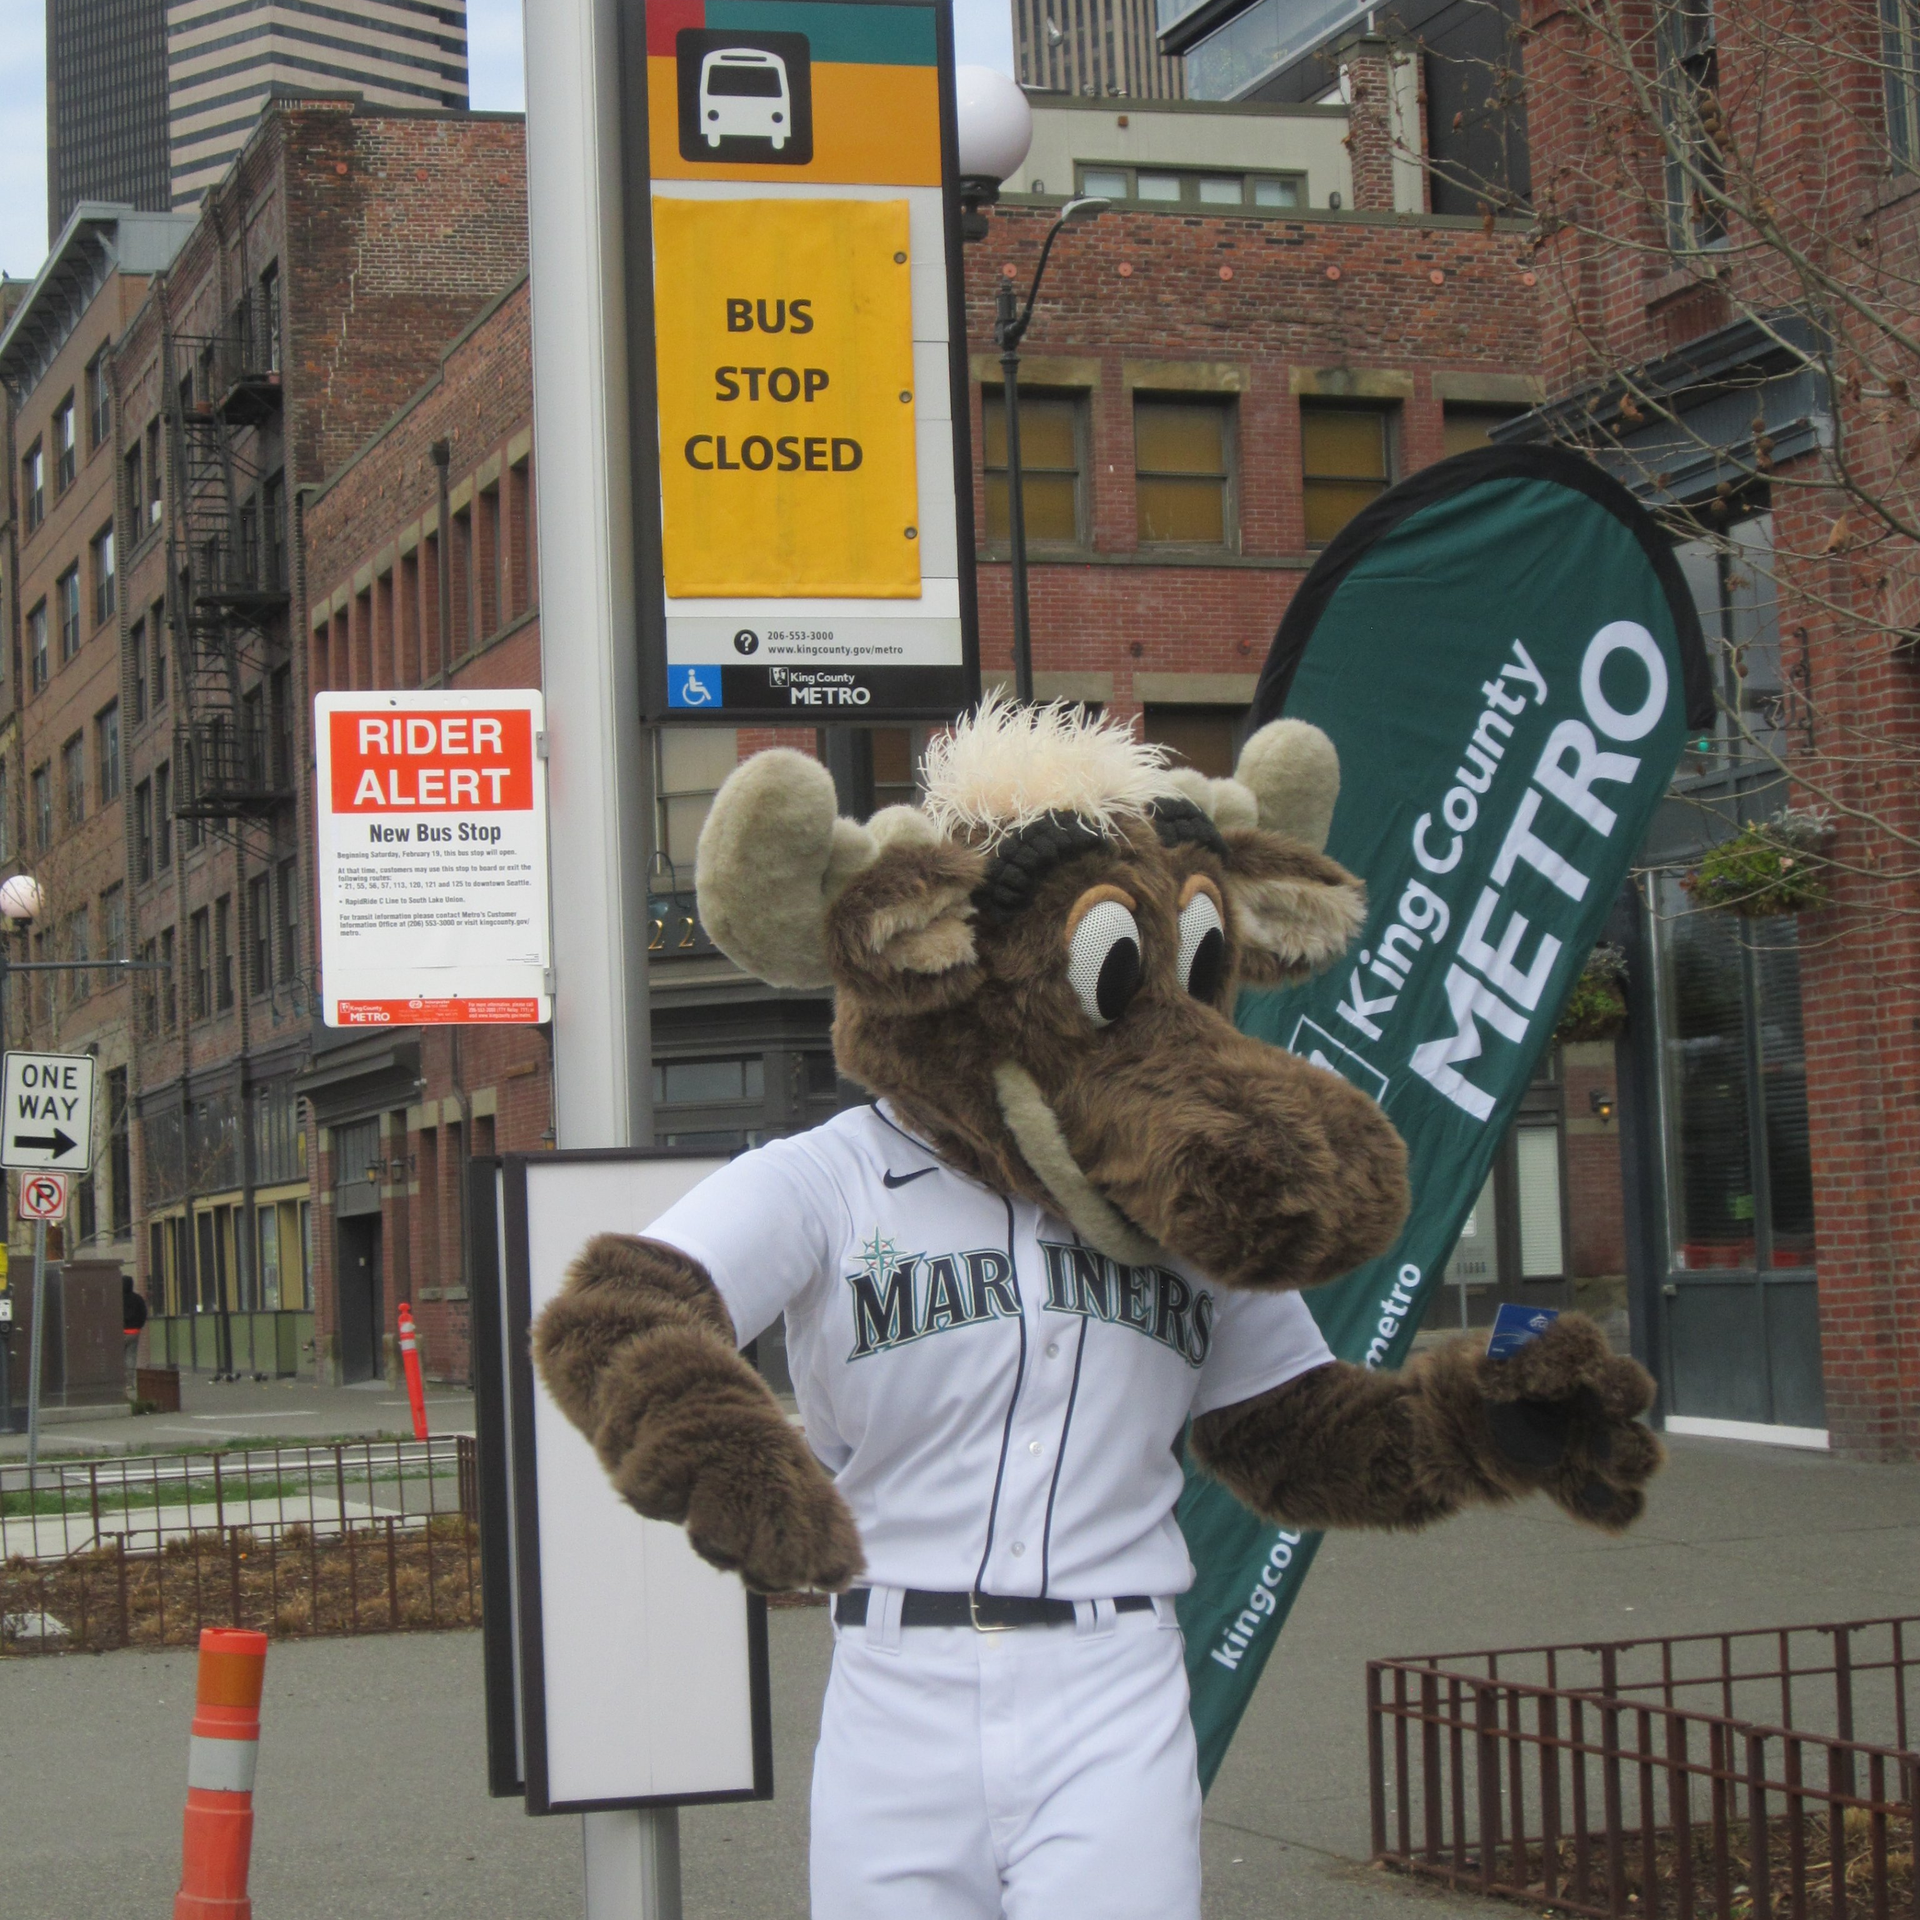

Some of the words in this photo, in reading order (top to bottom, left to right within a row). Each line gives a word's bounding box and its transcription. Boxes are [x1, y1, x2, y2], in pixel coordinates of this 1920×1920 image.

[726, 298, 814, 334] BUS
[715, 365, 829, 403] STOP
[684, 434, 863, 472] CLOSED
[767, 631, 834, 640] 206-553-3000
[768, 644, 903, 656] www.kingcounty.gov/metro
[790, 672, 815, 684] King
[816, 672, 855, 684] County
[790, 687, 871, 705] METRO
[359, 718, 503, 755] RIDER
[353, 768, 511, 805] ALERT
[370, 824, 410, 843] New
[416, 823, 452, 842] Bus
[458, 822, 501, 845] Stop
[1336, 878, 1450, 1041] King
[1412, 638, 1547, 874] County
[371, 851, 401, 859] Saturday,
[402, 850, 430, 858] February
[1409, 620, 1668, 1122] METRO
[345, 898, 378, 906] RapidRide
[407, 920, 424, 928] (206)
[480, 918, 530, 927] kingcounty.gov/
[350, 1012, 390, 1021] METRO
[22, 1064, 77, 1090] ONE
[18, 1094, 79, 1121] WAY
